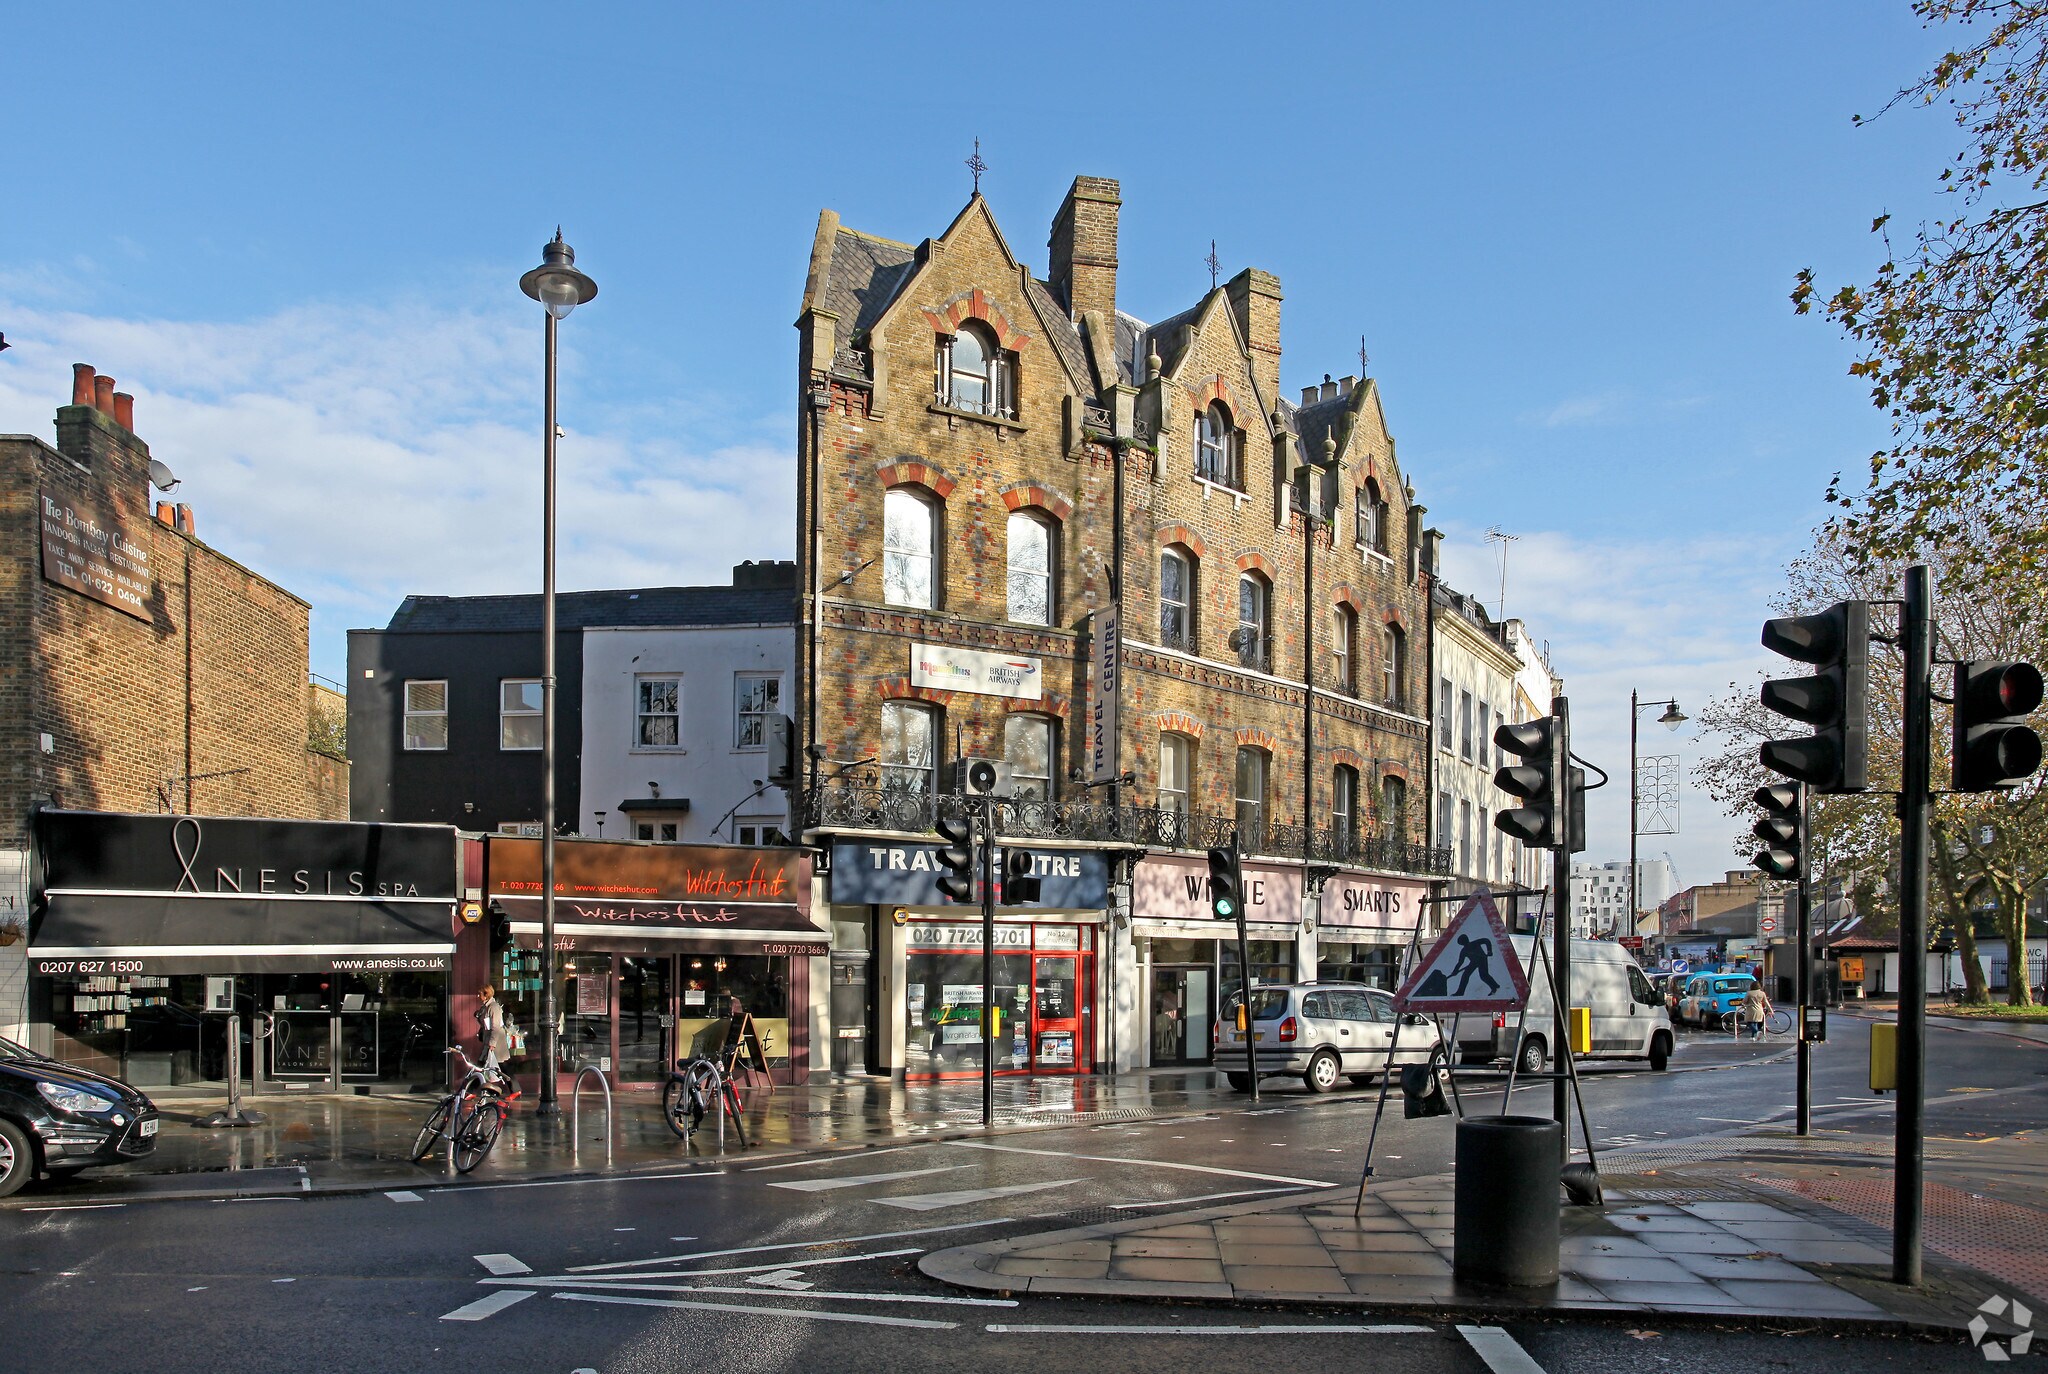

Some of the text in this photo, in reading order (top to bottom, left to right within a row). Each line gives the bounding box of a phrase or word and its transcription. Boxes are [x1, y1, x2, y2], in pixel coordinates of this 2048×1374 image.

[42, 495, 147, 562] The Bombay Cuisine
[43, 520, 81, 545] TANDOORI
[109, 552, 149, 578] RESTAURANT
[47, 542, 148, 595] TAKE AWAY SERVICE AVAILABLE
[57, 560, 77, 579] TEL
[117, 588, 142, 607] 0494
[987, 675, 1021, 686] AIRWAYS
[989, 667, 1020, 678] BRITISH
[1095, 618, 1115, 772] TRAVEL CENTRE
[687, 858, 788, 899] Witches Hut
[378, 882, 419, 897] SPA
[510, 881, 525, 890] 020
[574, 884, 658, 894] www.witcheshut.com
[1343, 888, 1400, 913] SMARTS
[573, 903, 738, 922] Witches Hut
[912, 928, 1025, 944] 020 7720 8701
[772, 944, 787, 953] 020
[788, 945, 806, 954] 7720
[808, 946, 826, 954] 3666
[40, 960, 144, 973] 0207 627 1500
[331, 956, 445, 969] www.anesis.co.uk
